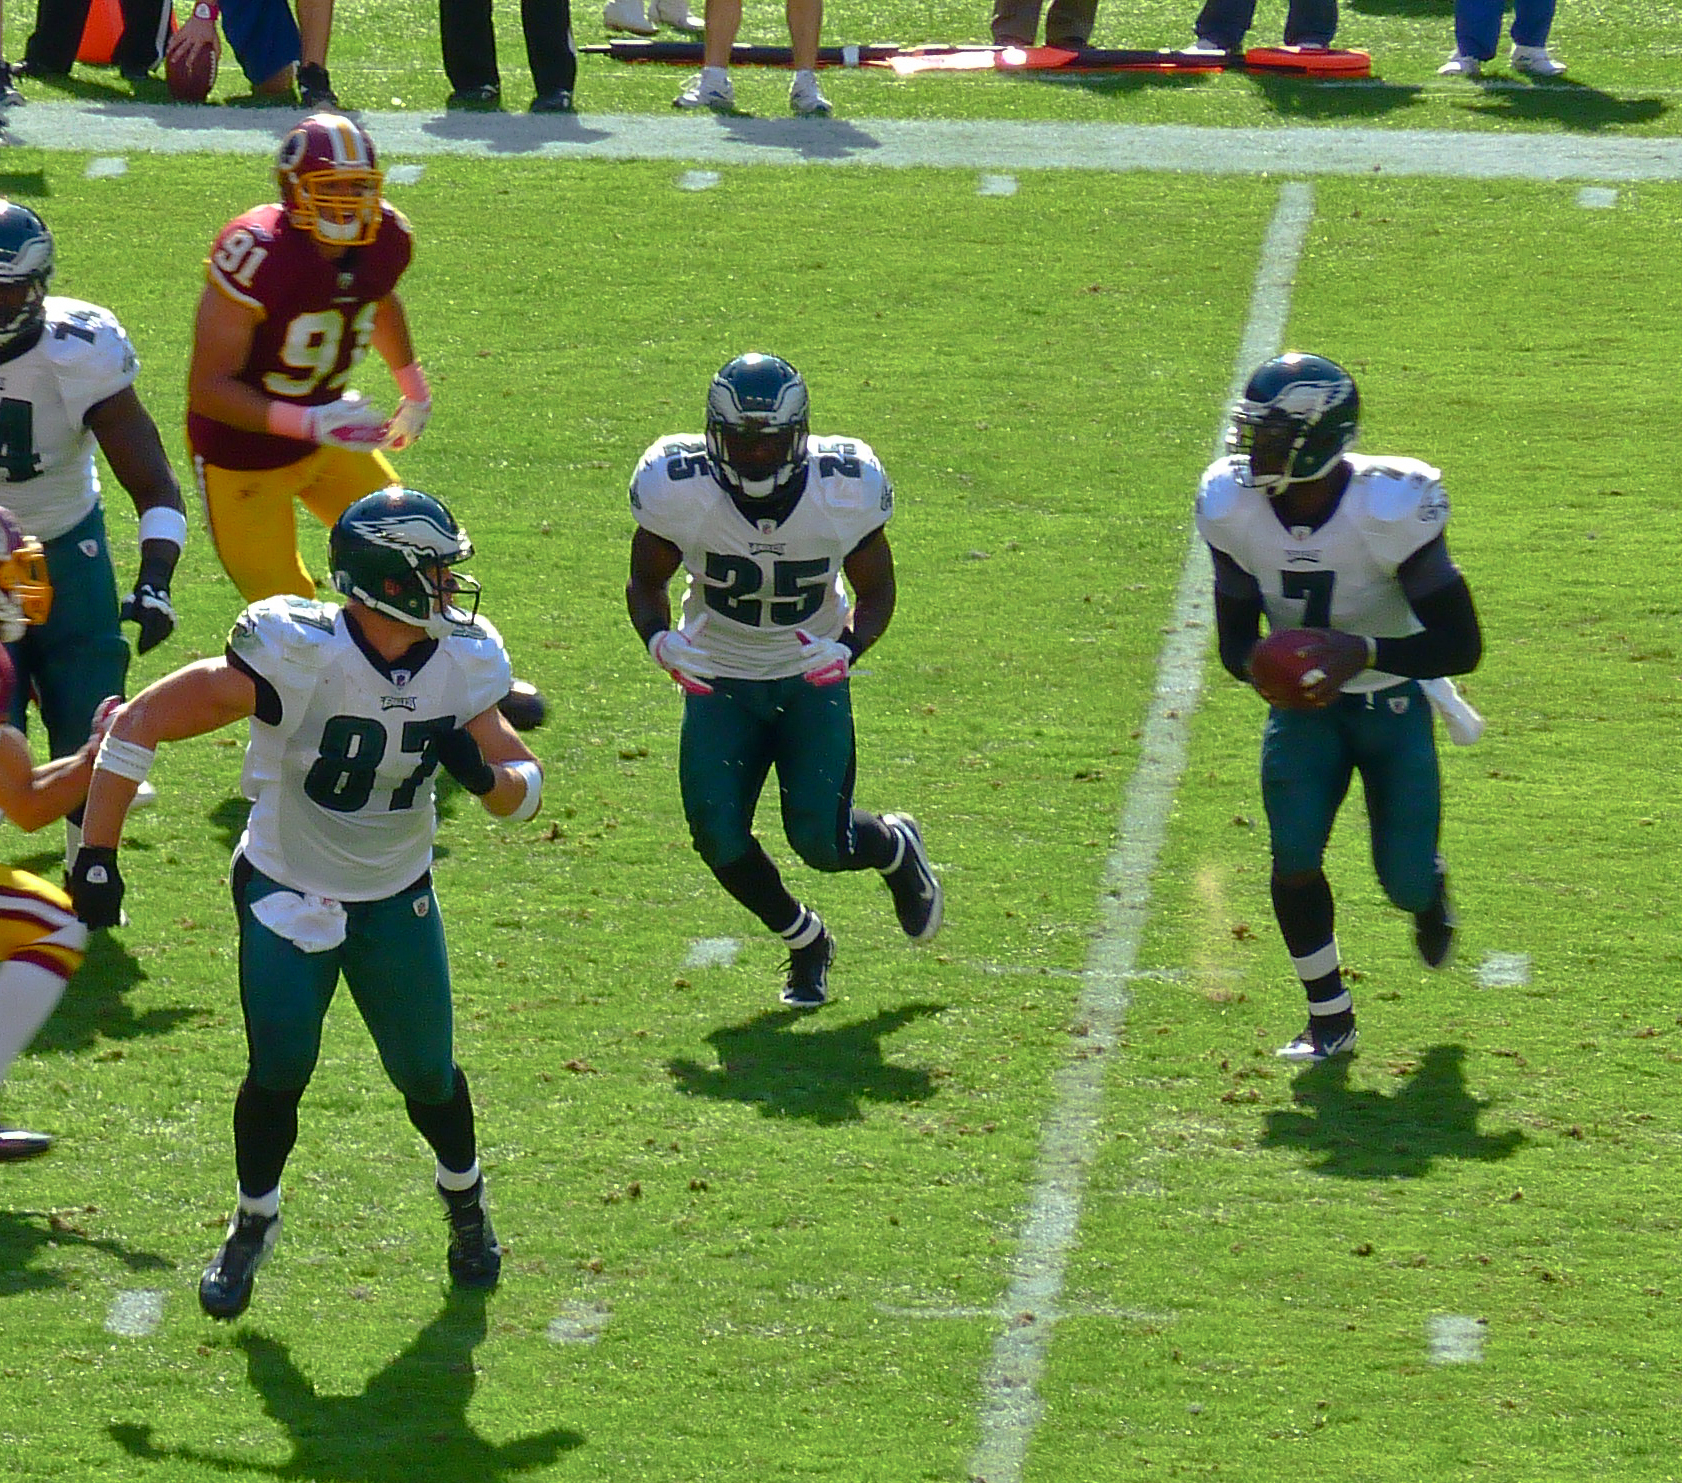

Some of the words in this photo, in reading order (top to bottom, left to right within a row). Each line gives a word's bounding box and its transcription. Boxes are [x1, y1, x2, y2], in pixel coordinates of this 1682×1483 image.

[213, 230, 268, 288] 91
[704, 551, 831, 628] 25
[1280, 569, 1336, 629] 7
[304, 714, 457, 813] 87
